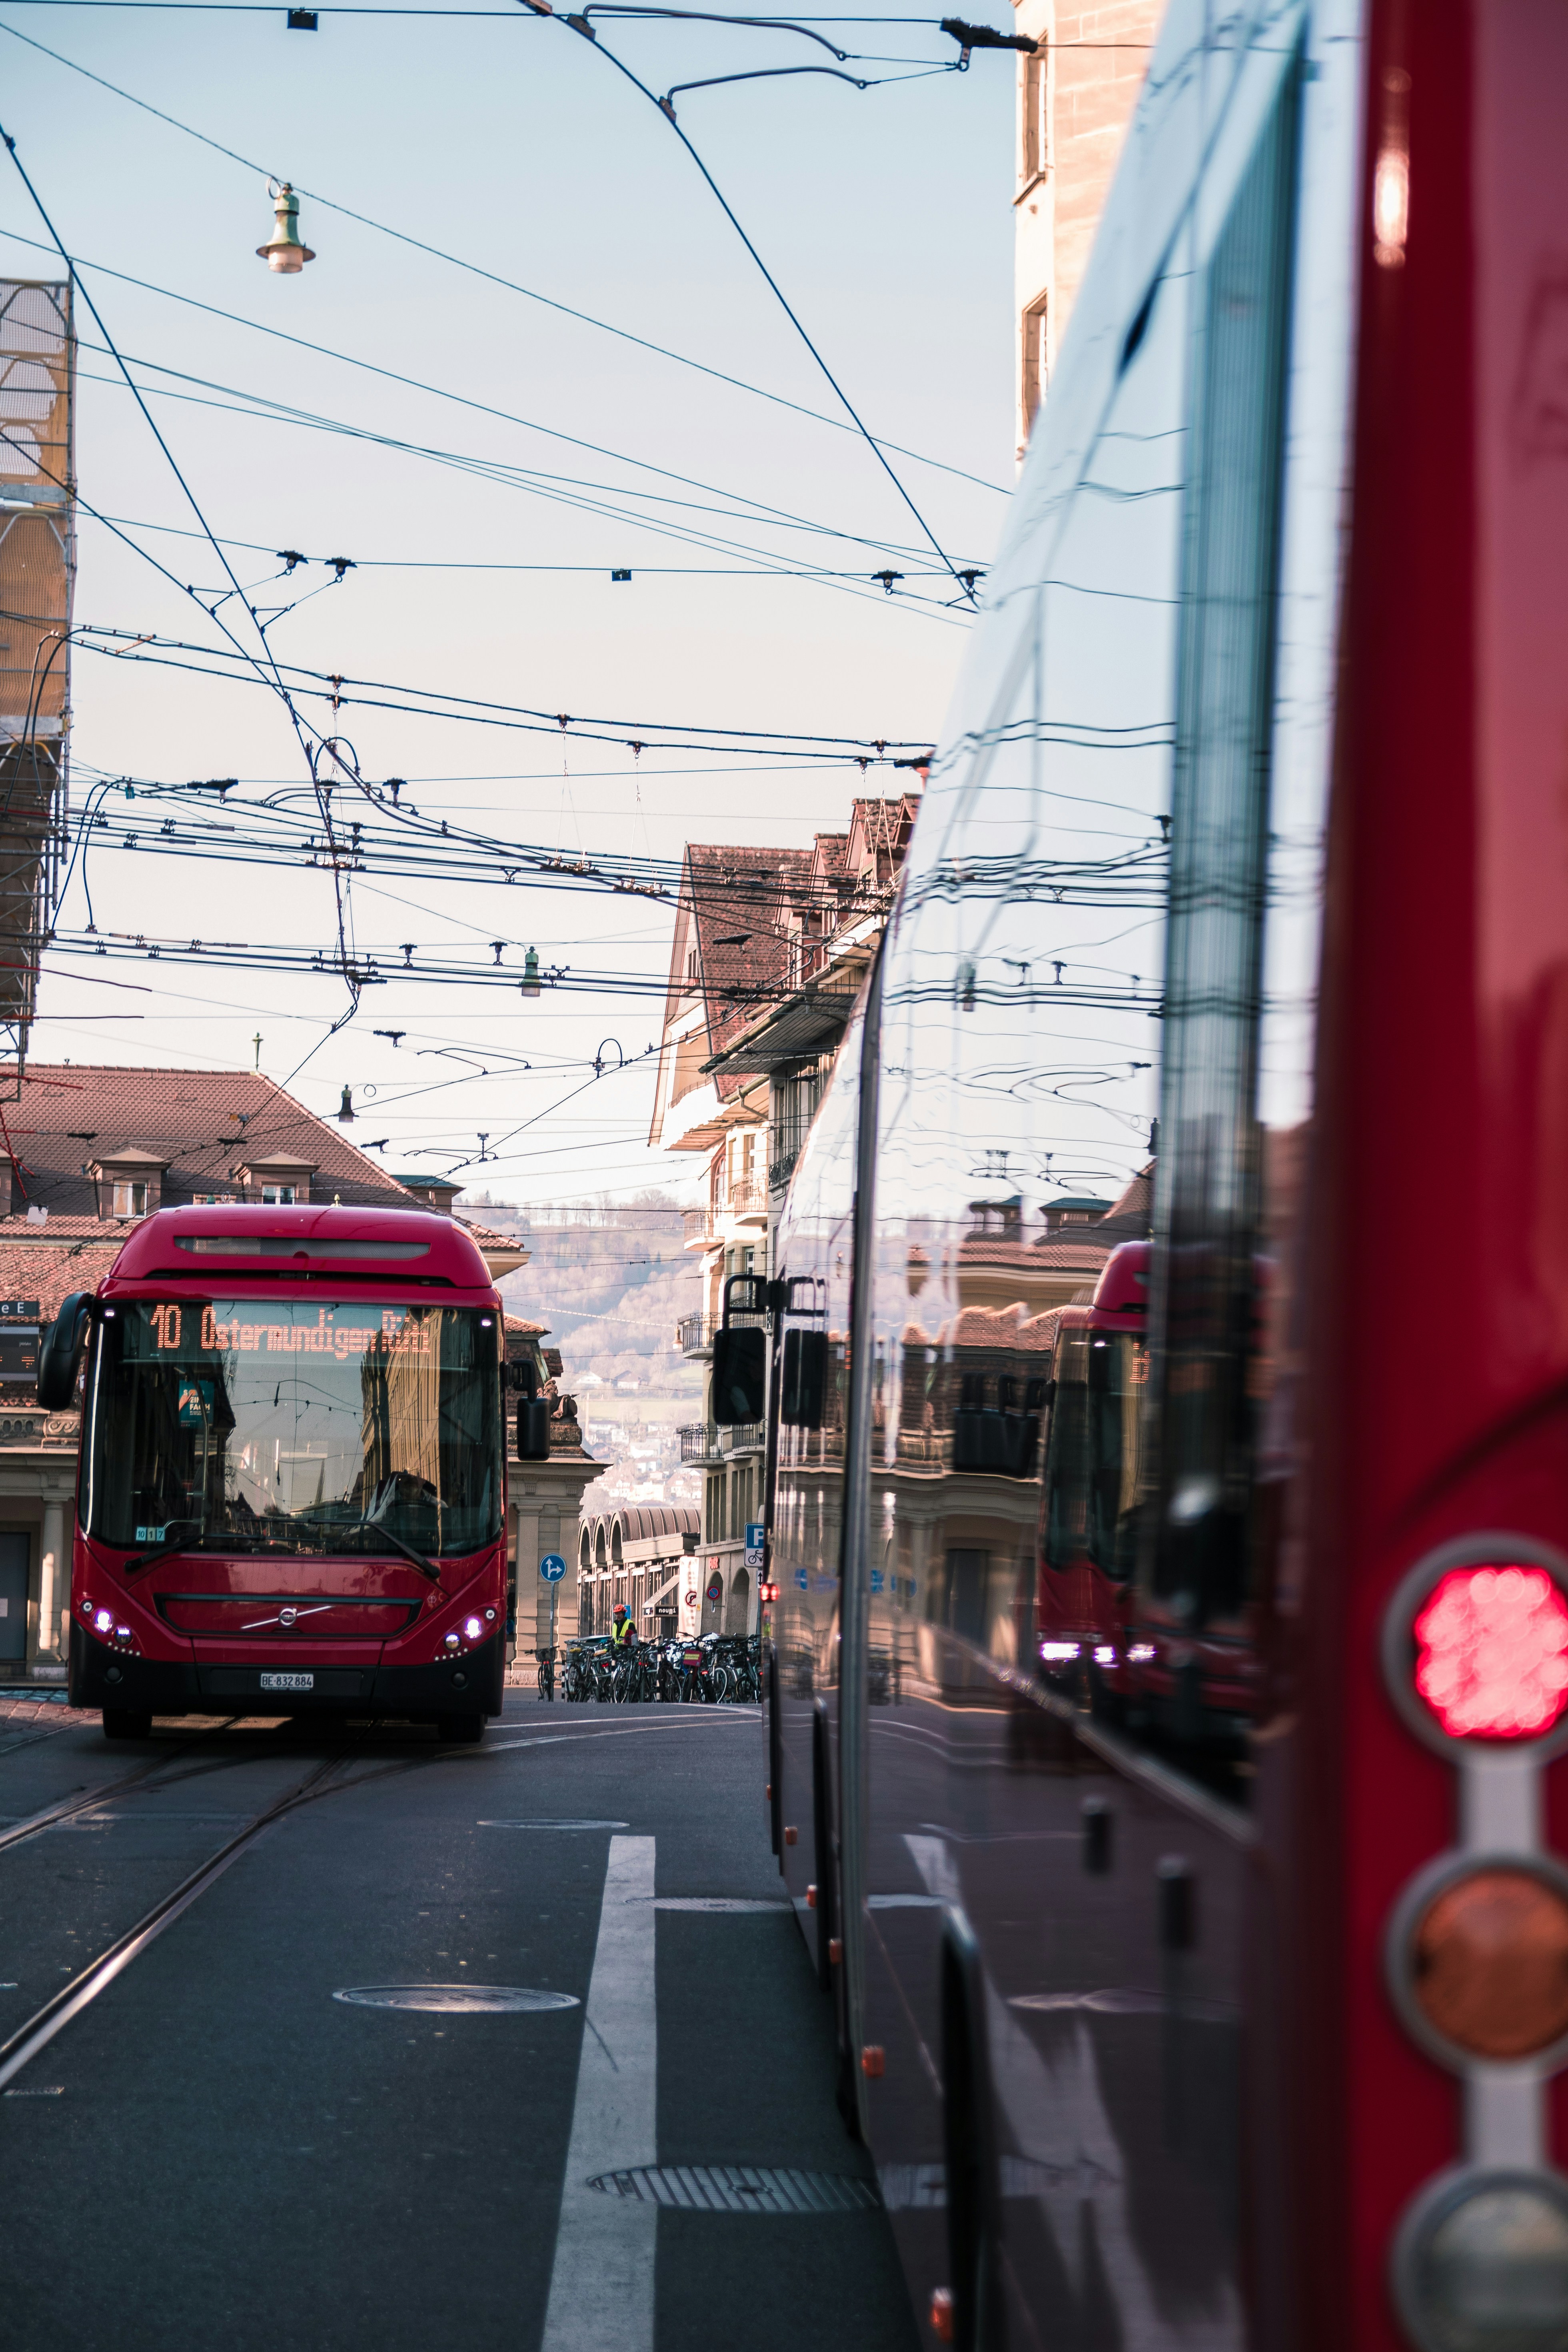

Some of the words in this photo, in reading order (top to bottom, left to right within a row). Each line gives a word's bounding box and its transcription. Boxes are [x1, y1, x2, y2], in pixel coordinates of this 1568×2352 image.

[17, 1302, 24, 1313] E
[150, 1305, 181, 1348] 10
[754, 1528, 764, 1546] P
